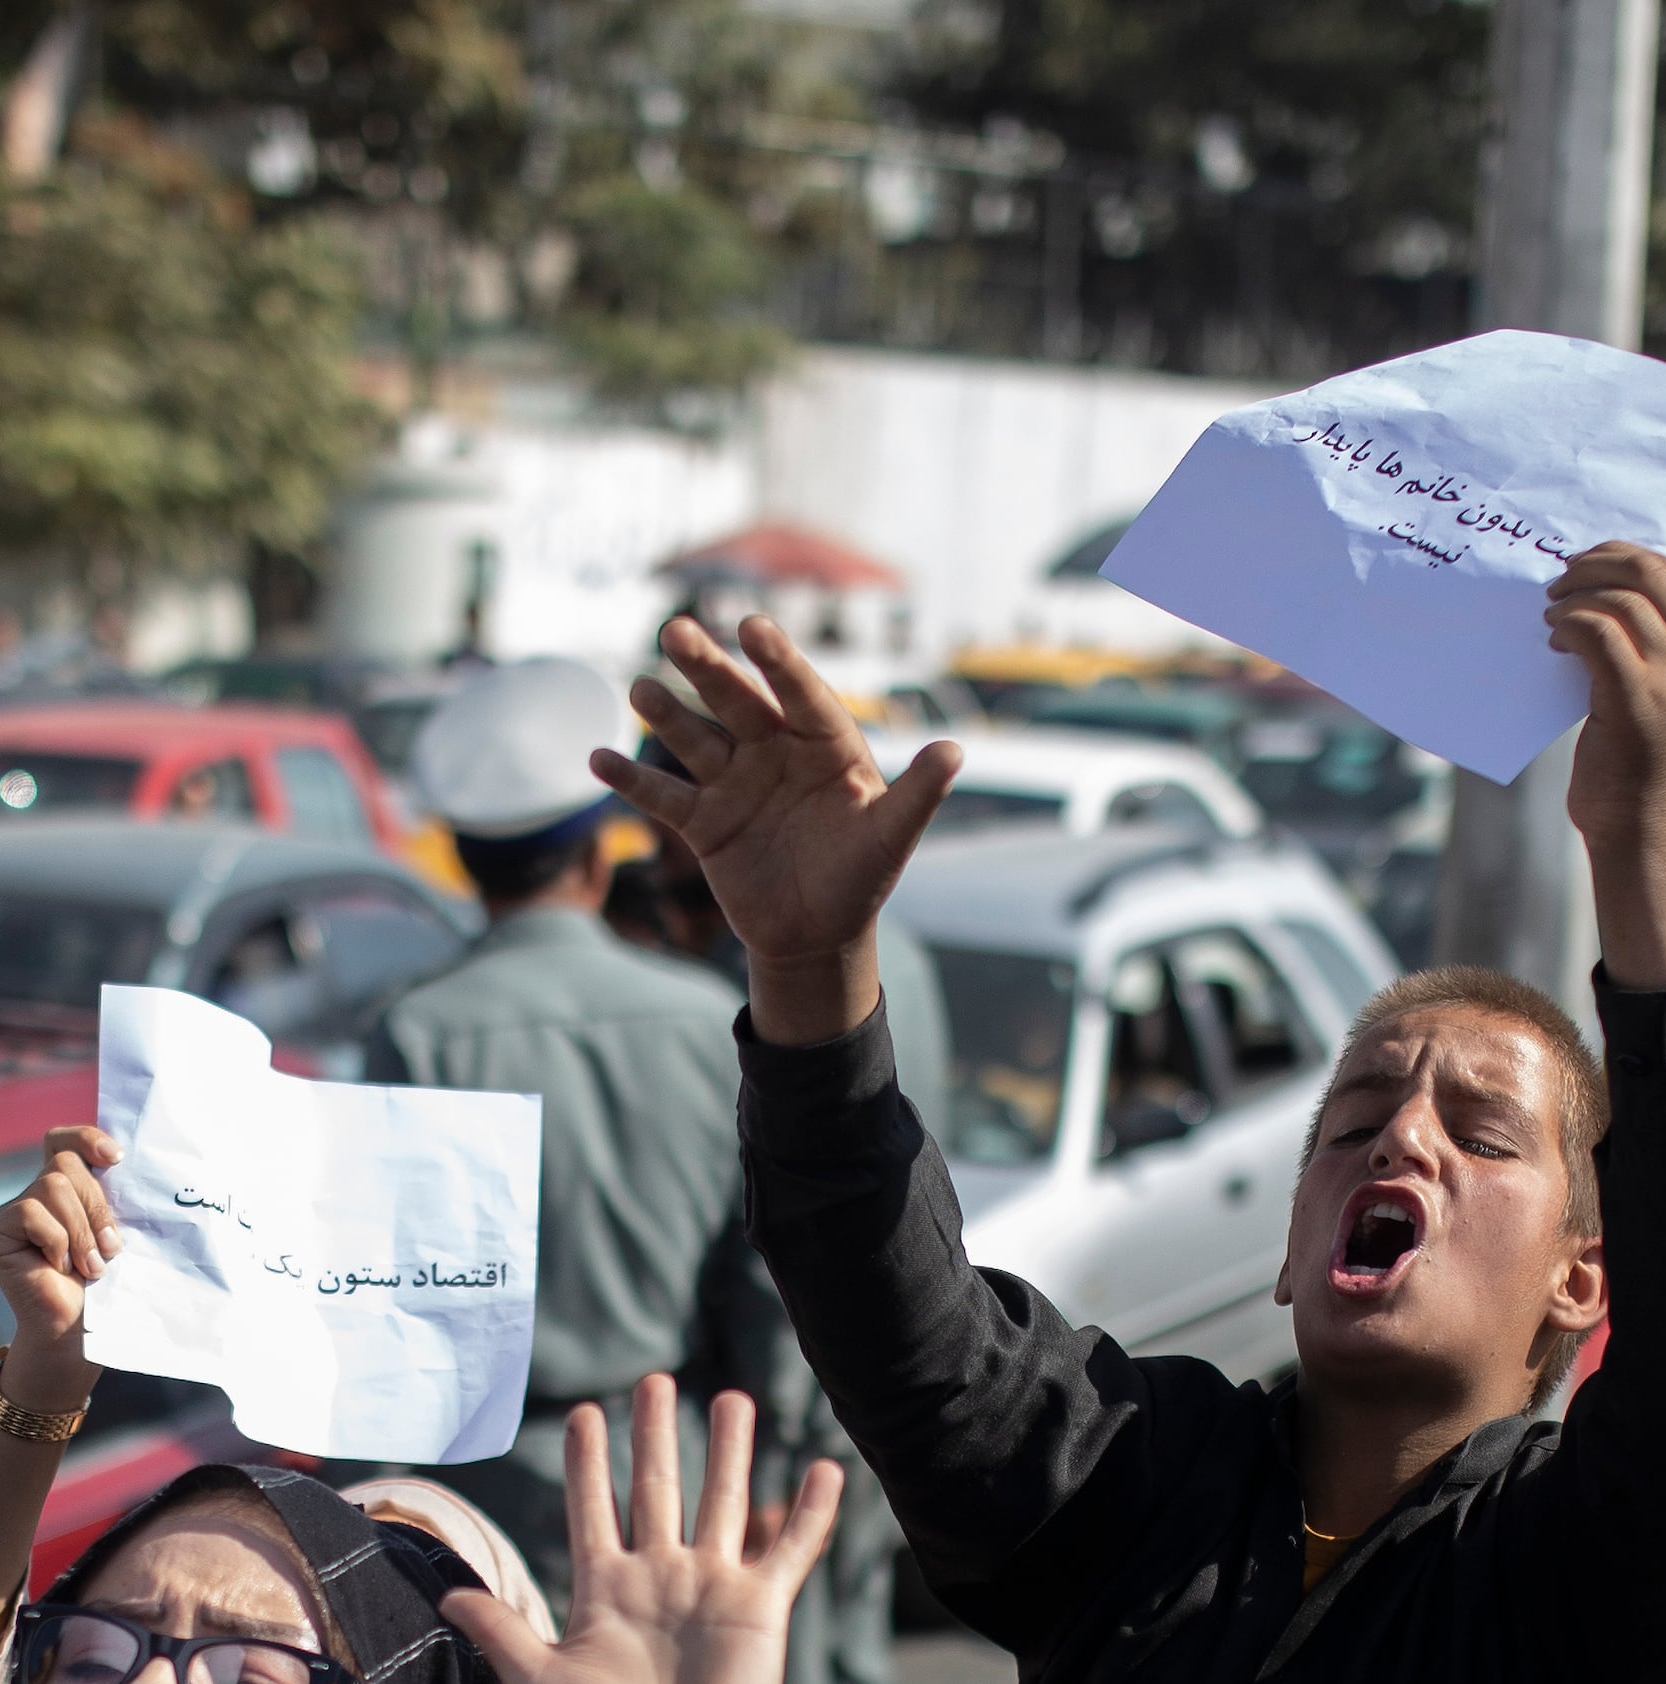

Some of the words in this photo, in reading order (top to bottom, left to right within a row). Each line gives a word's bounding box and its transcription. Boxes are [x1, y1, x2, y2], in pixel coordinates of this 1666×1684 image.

[1292, 422, 1374, 472] پایدار
[1375, 450, 1403, 477] ها
[1394, 474, 1468, 502] خانم
[1456, 503, 1532, 546] بدون
[173, 1187, 233, 1216] است
[262, 1254, 305, 1290] یک
[317, 1268, 402, 1296] ستون
[412, 1261, 509, 1290] اقتصاد
